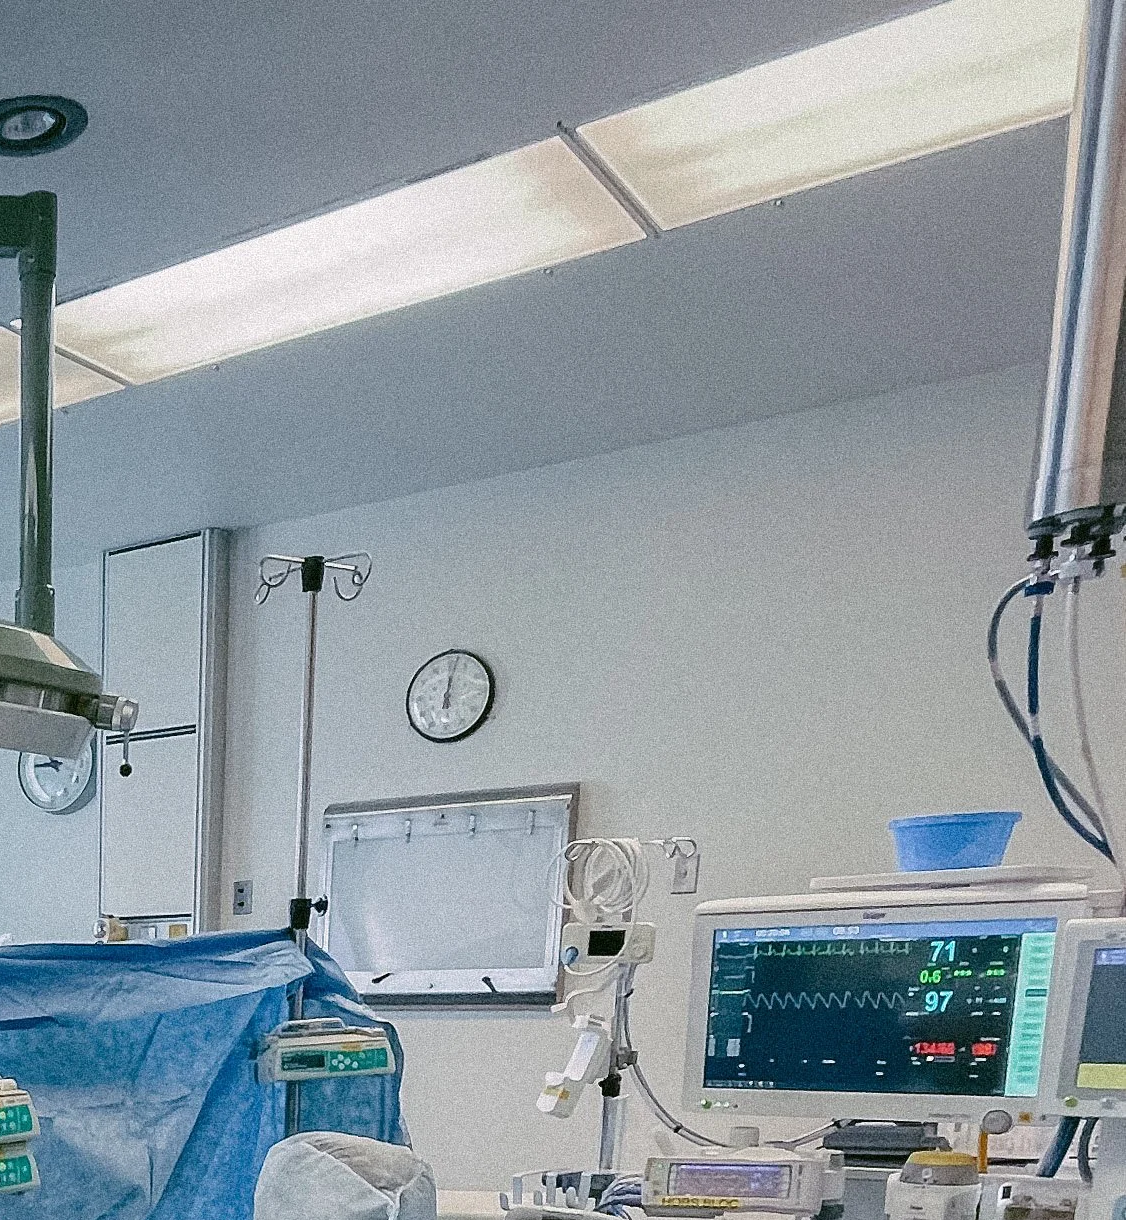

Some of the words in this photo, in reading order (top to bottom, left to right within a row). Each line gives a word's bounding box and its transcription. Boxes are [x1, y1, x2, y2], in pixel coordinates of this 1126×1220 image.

[930, 940, 956, 962] 71
[919, 969, 942, 984] 0.6
[924, 990, 954, 1013] 97
